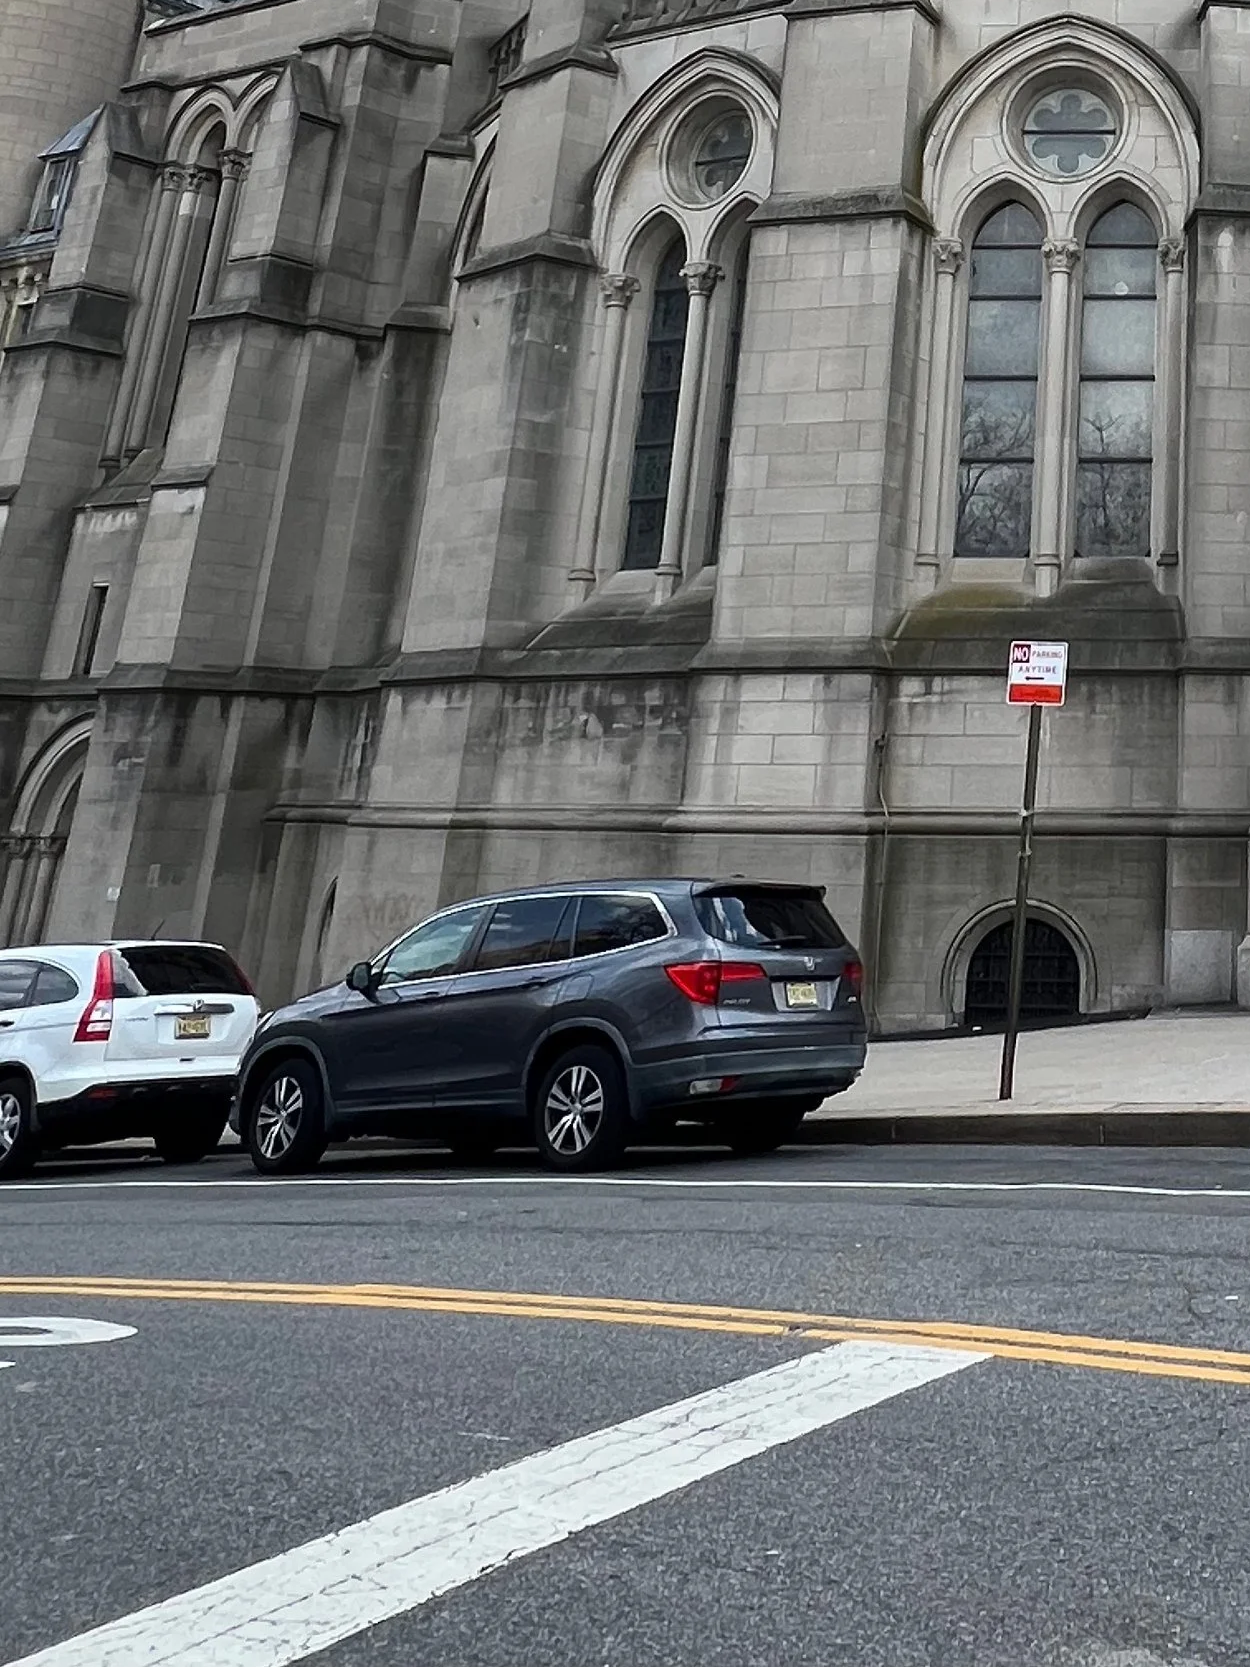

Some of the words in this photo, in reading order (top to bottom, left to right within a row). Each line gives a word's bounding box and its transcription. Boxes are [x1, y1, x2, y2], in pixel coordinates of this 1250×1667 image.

[1014, 647, 1028, 661] NO
[1032, 650, 1062, 658] PARKING
[1018, 665, 1057, 674] ANYTIME
